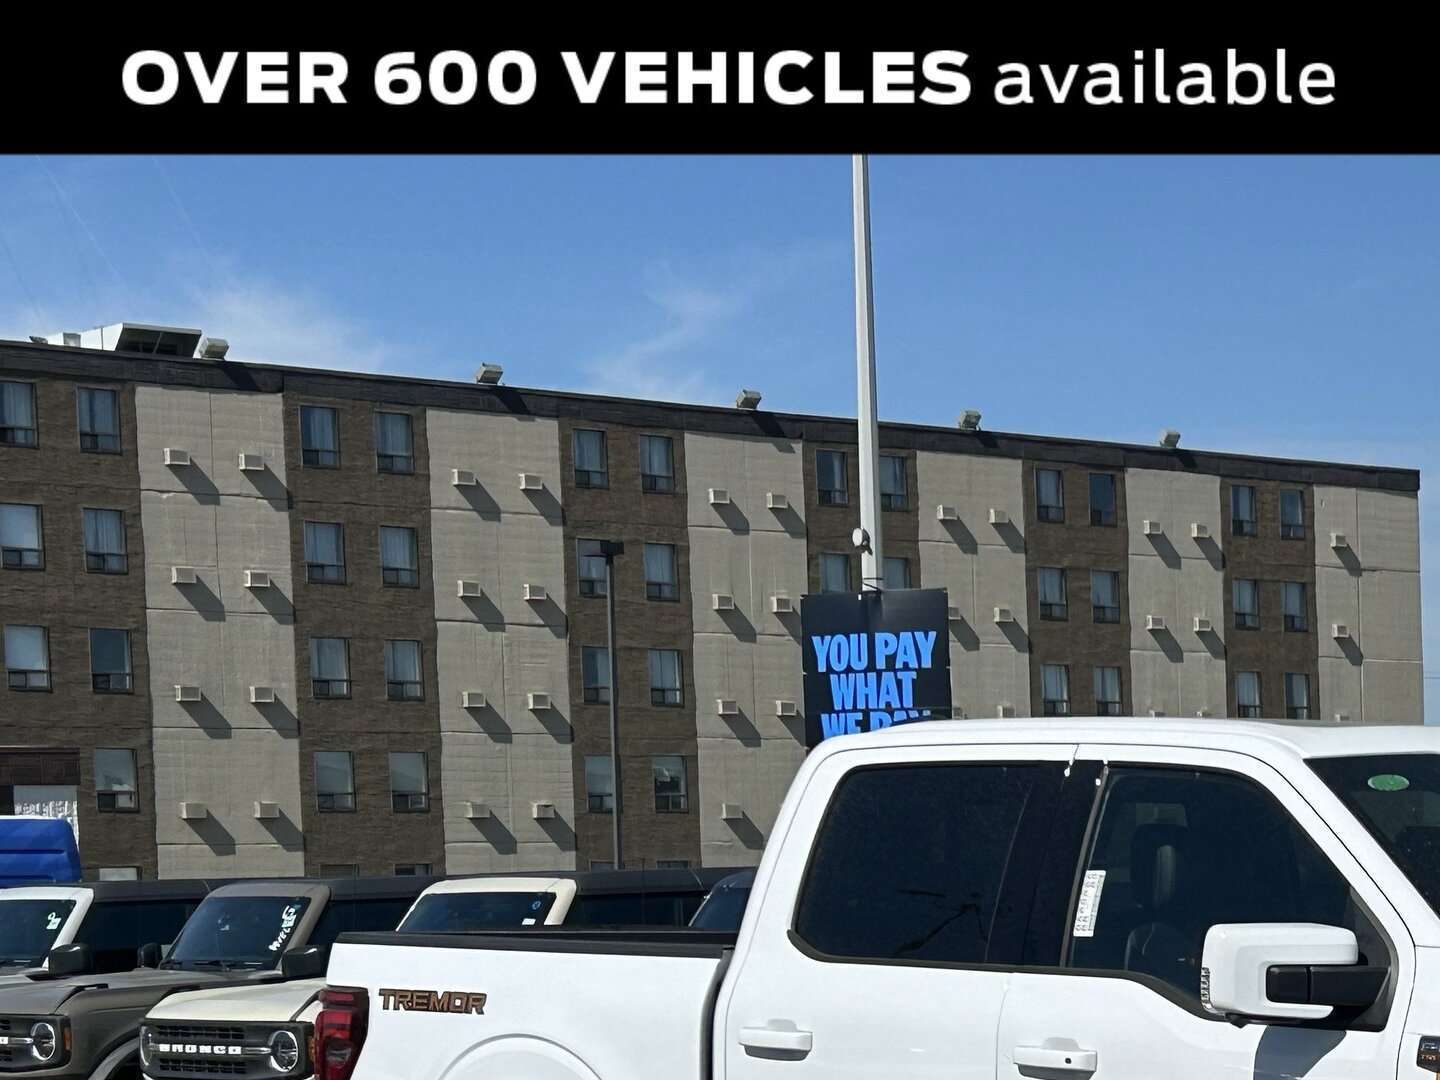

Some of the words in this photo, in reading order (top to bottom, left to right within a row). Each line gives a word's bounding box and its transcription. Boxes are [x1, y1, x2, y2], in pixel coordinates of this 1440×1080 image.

[811, 632, 868, 672] YOU
[874, 631, 937, 669] PAY
[830, 671, 917, 710] WHAT
[379, 988, 487, 1015] TREMOR
